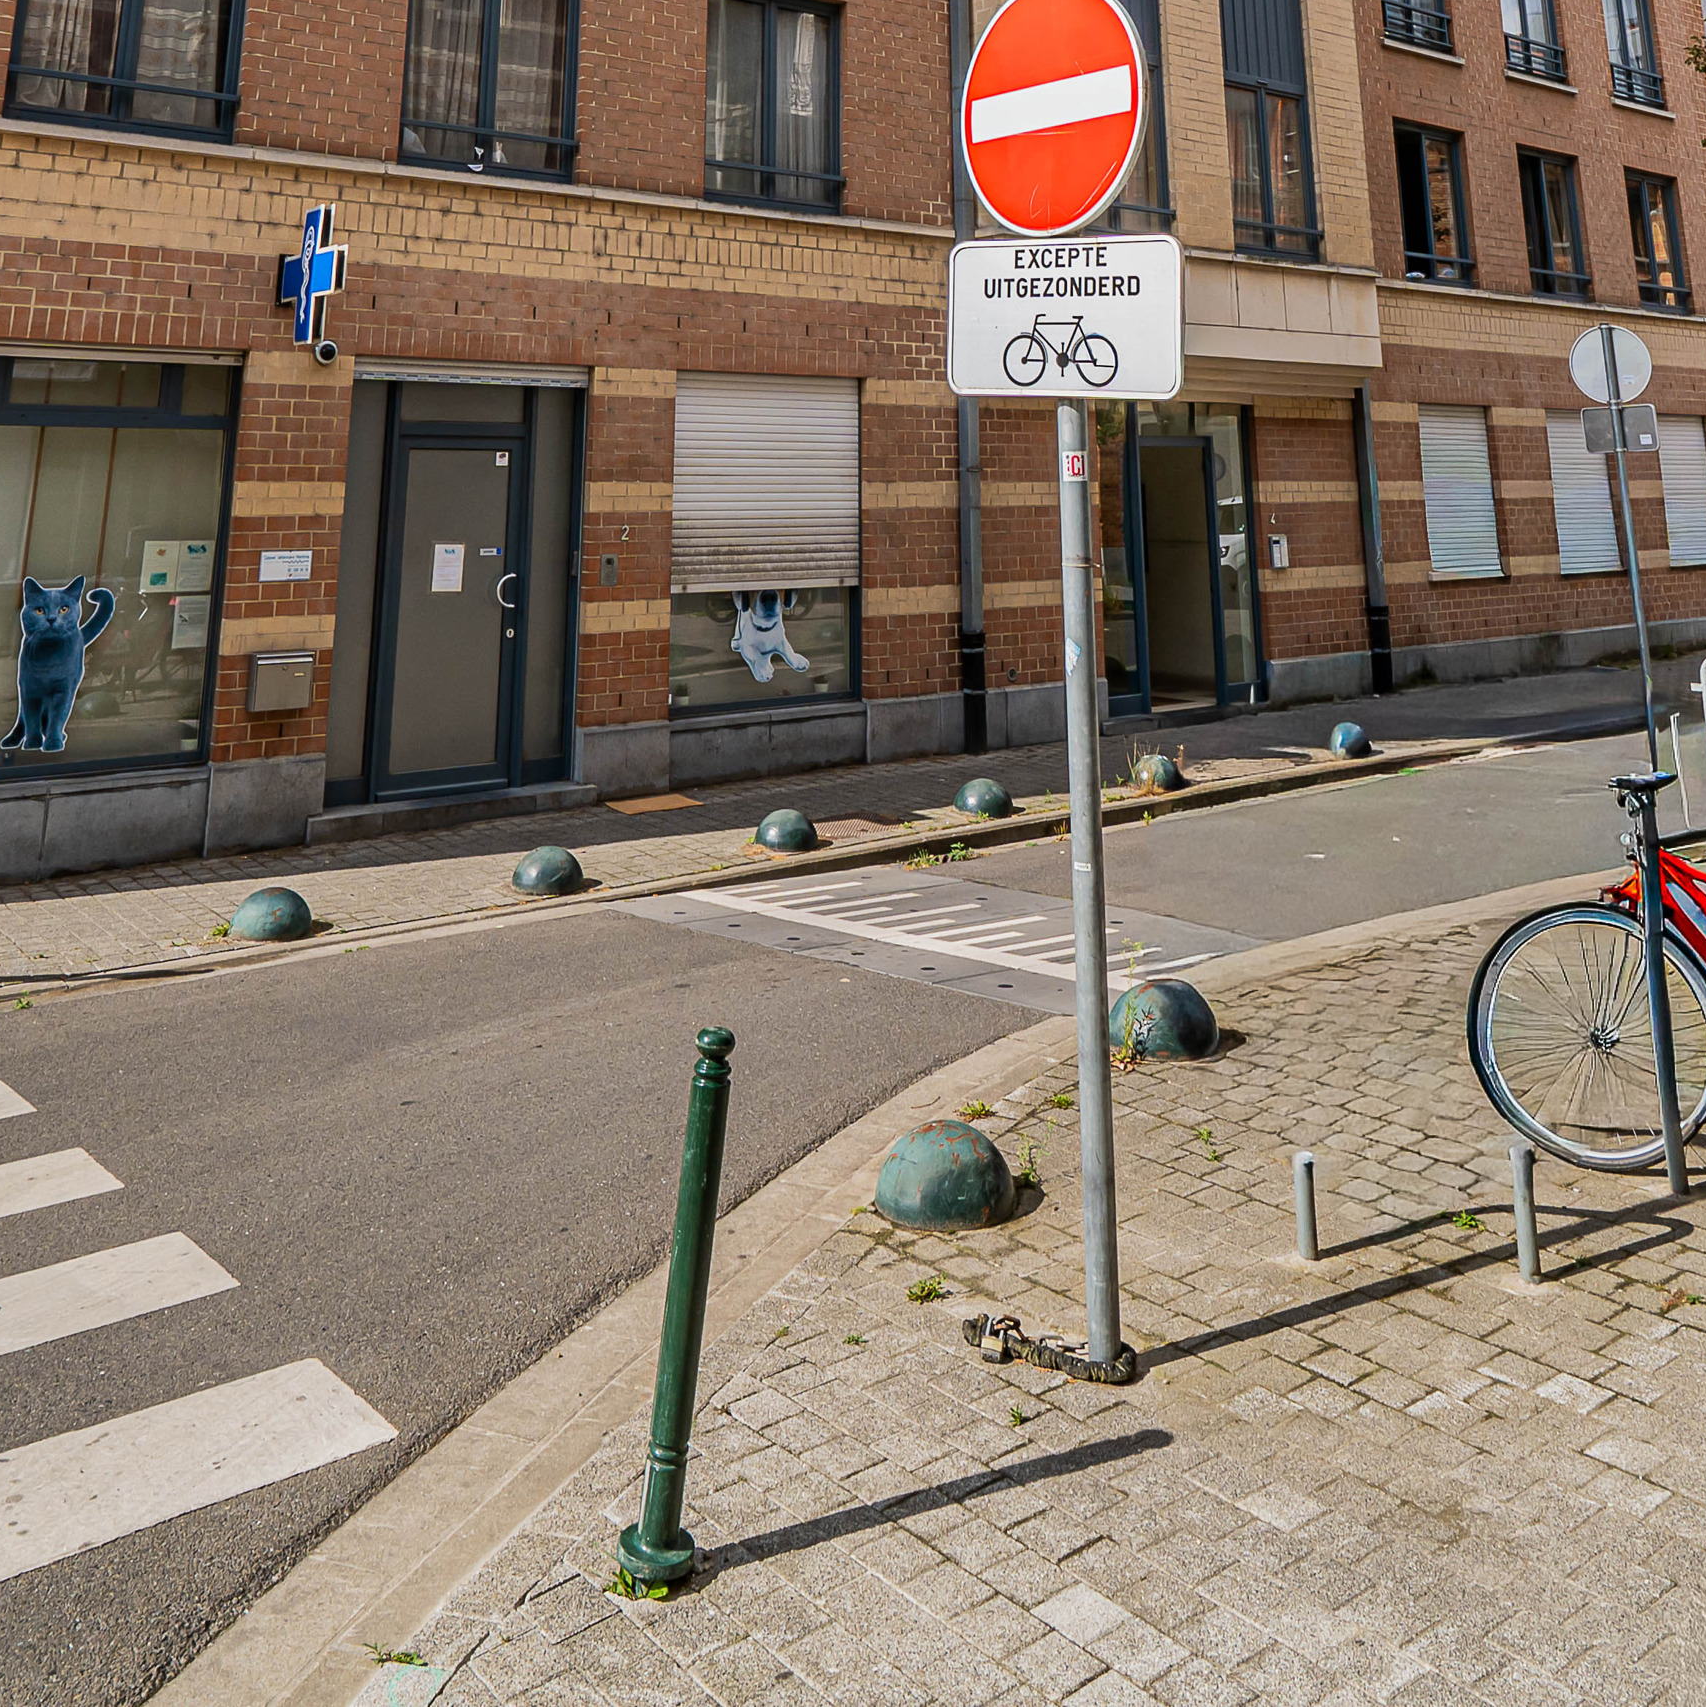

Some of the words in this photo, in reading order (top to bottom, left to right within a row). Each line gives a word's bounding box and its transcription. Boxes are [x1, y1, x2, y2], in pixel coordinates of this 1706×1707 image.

[1014, 246, 1108, 270] EXCEPTE
[984, 275, 1141, 299] UITGEZONDERD
[621, 525, 630, 541] 2
